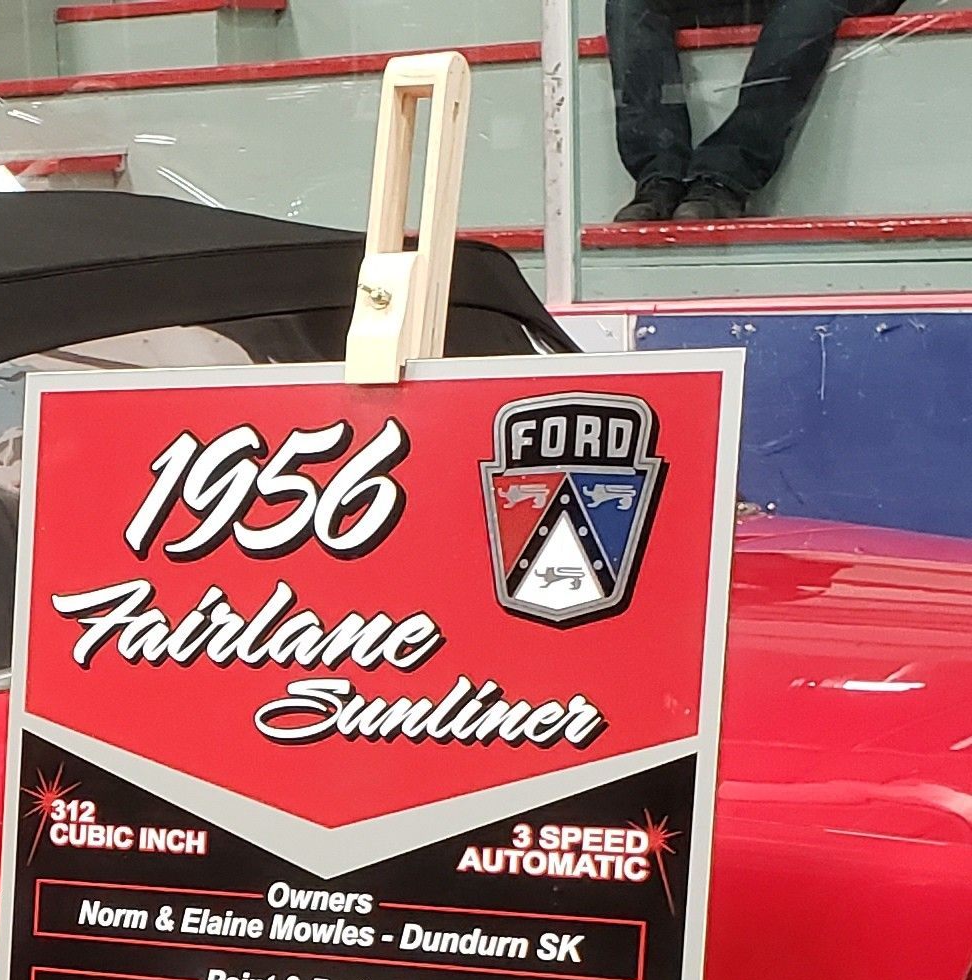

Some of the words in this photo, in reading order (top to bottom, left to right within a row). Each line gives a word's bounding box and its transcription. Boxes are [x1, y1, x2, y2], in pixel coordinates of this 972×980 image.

[511, 414, 633, 460] FORD
[125, 418, 408, 558] 1956
[51, 579, 441, 668] Fairlane
[254, 675, 605, 746] Sunliner
[50, 798, 96, 824] 312
[49, 822, 135, 850] CUBIC
[138, 827, 208, 855] INCH
[512, 823, 532, 849] 3
[538, 826, 650, 854] SPEED
[456, 846, 650, 882] AUTOMATIC
[267, 881, 374, 915] Owners
[77, 899, 149, 930] Norm
[154, 905, 175, 932] &
[180, 907, 264, 939] Elaine
[268, 913, 376, 948] Mowles
[380, 934, 394, 943] -
[399, 923, 529, 960] Dundurn
[536, 932, 586, 963] SK
